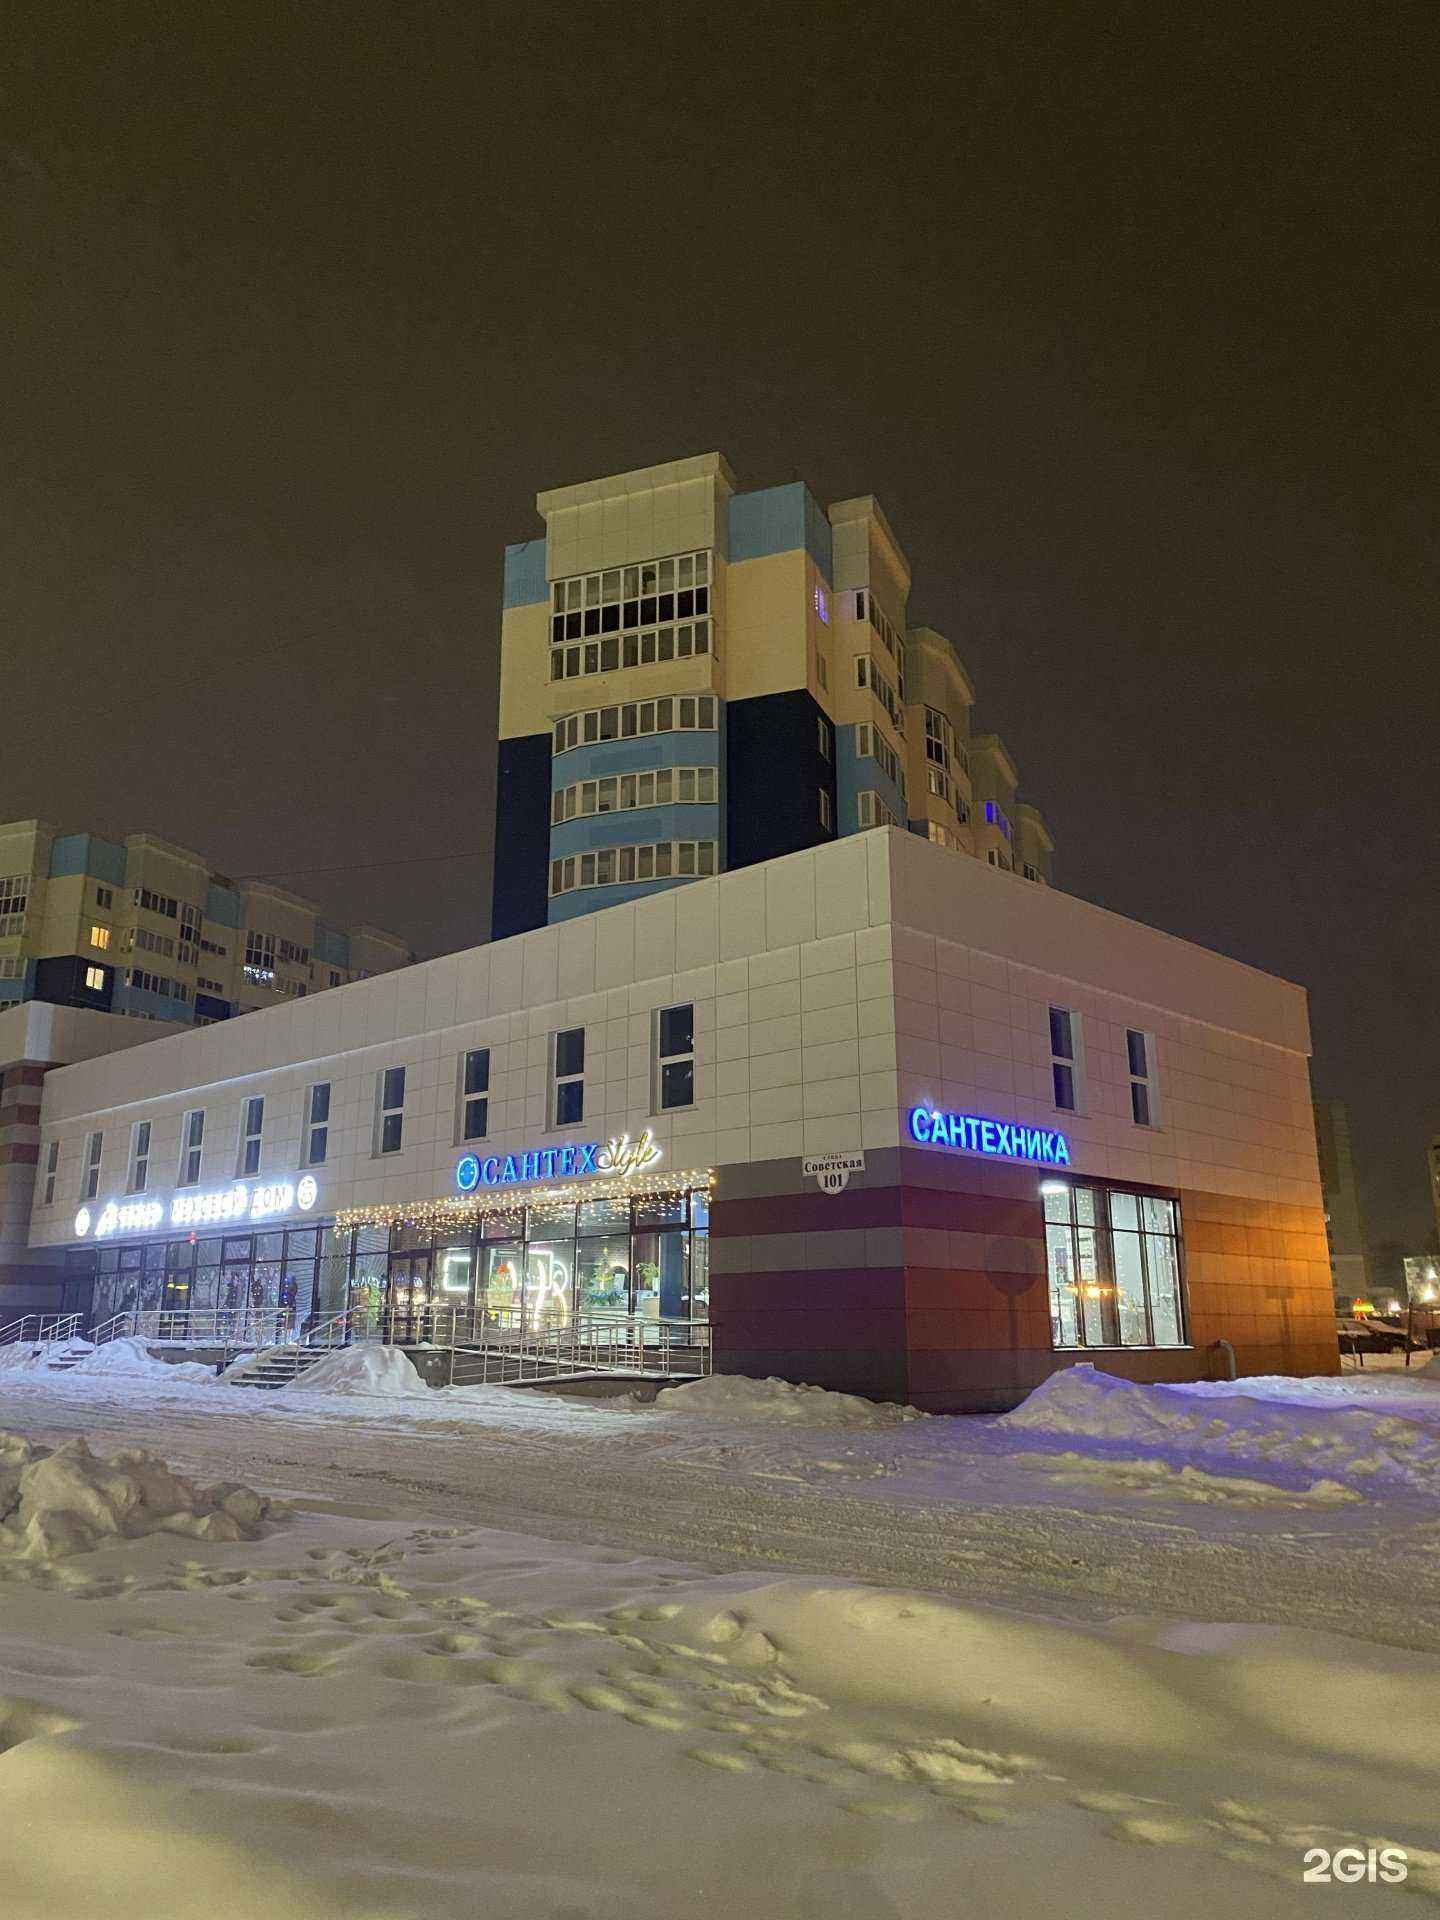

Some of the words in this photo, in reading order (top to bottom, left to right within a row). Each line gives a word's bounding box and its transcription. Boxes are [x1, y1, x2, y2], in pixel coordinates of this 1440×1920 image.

[911, 1108, 1070, 1165] САНТЕХНИКА
[483, 1144, 598, 1184] САНТЕХ
[804, 1159, 863, 1173] Советская
[823, 1173, 843, 1188] 101
